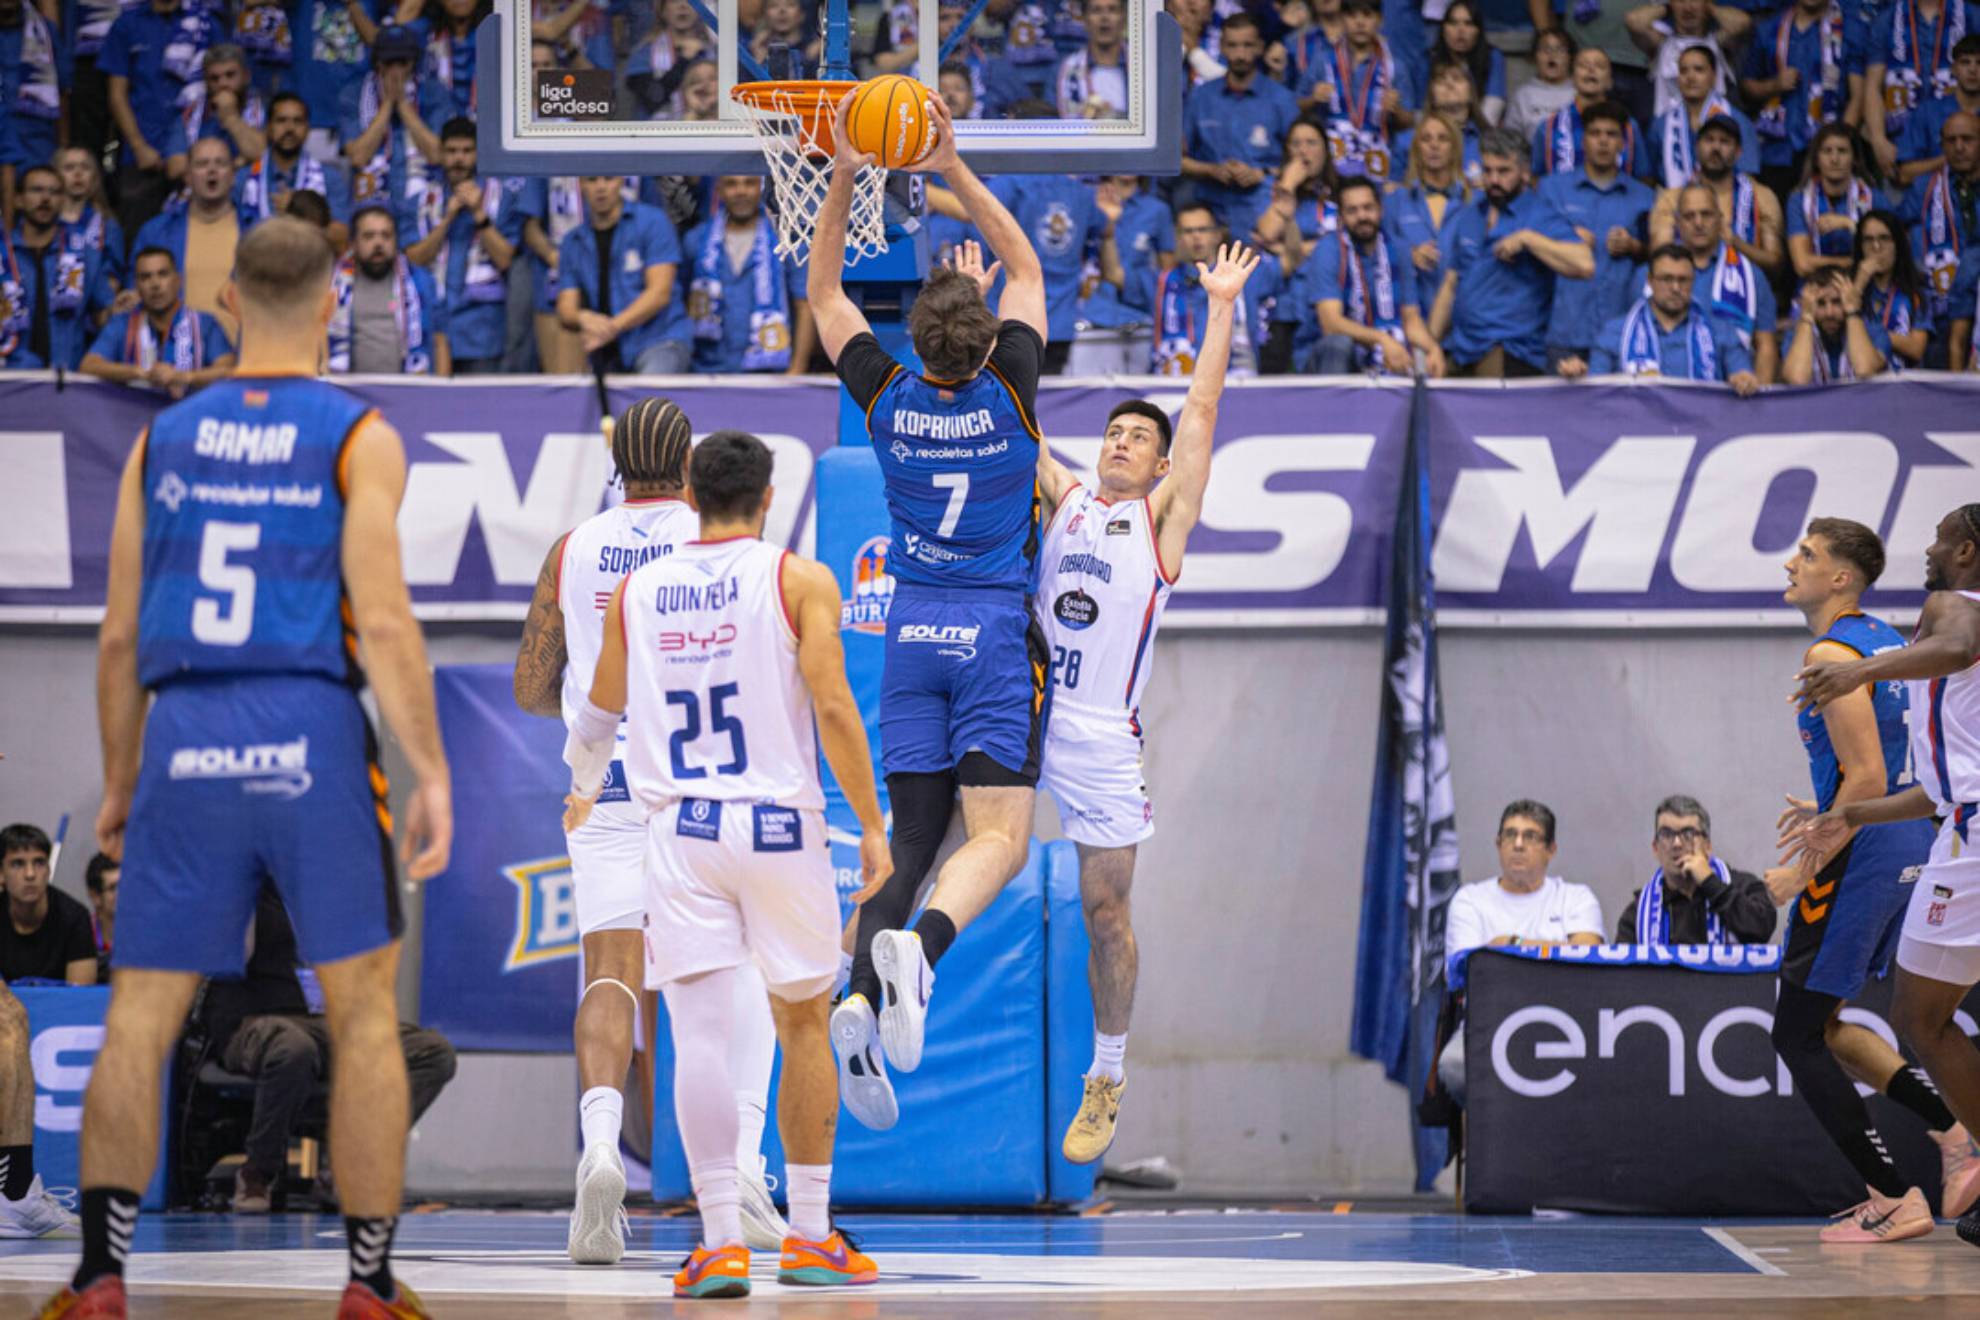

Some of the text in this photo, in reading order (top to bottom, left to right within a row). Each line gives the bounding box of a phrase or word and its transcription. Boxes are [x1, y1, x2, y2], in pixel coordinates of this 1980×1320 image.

[541, 83, 572, 101] liga
[541, 99, 609, 114] endesa
[194, 416, 298, 465] SAMAR
[916, 438, 1009, 460] recoletas salud
[932, 472, 970, 539] 7
[191, 519, 261, 647] 5
[1052, 645, 1083, 690] 28
[665, 681, 748, 779] 25
